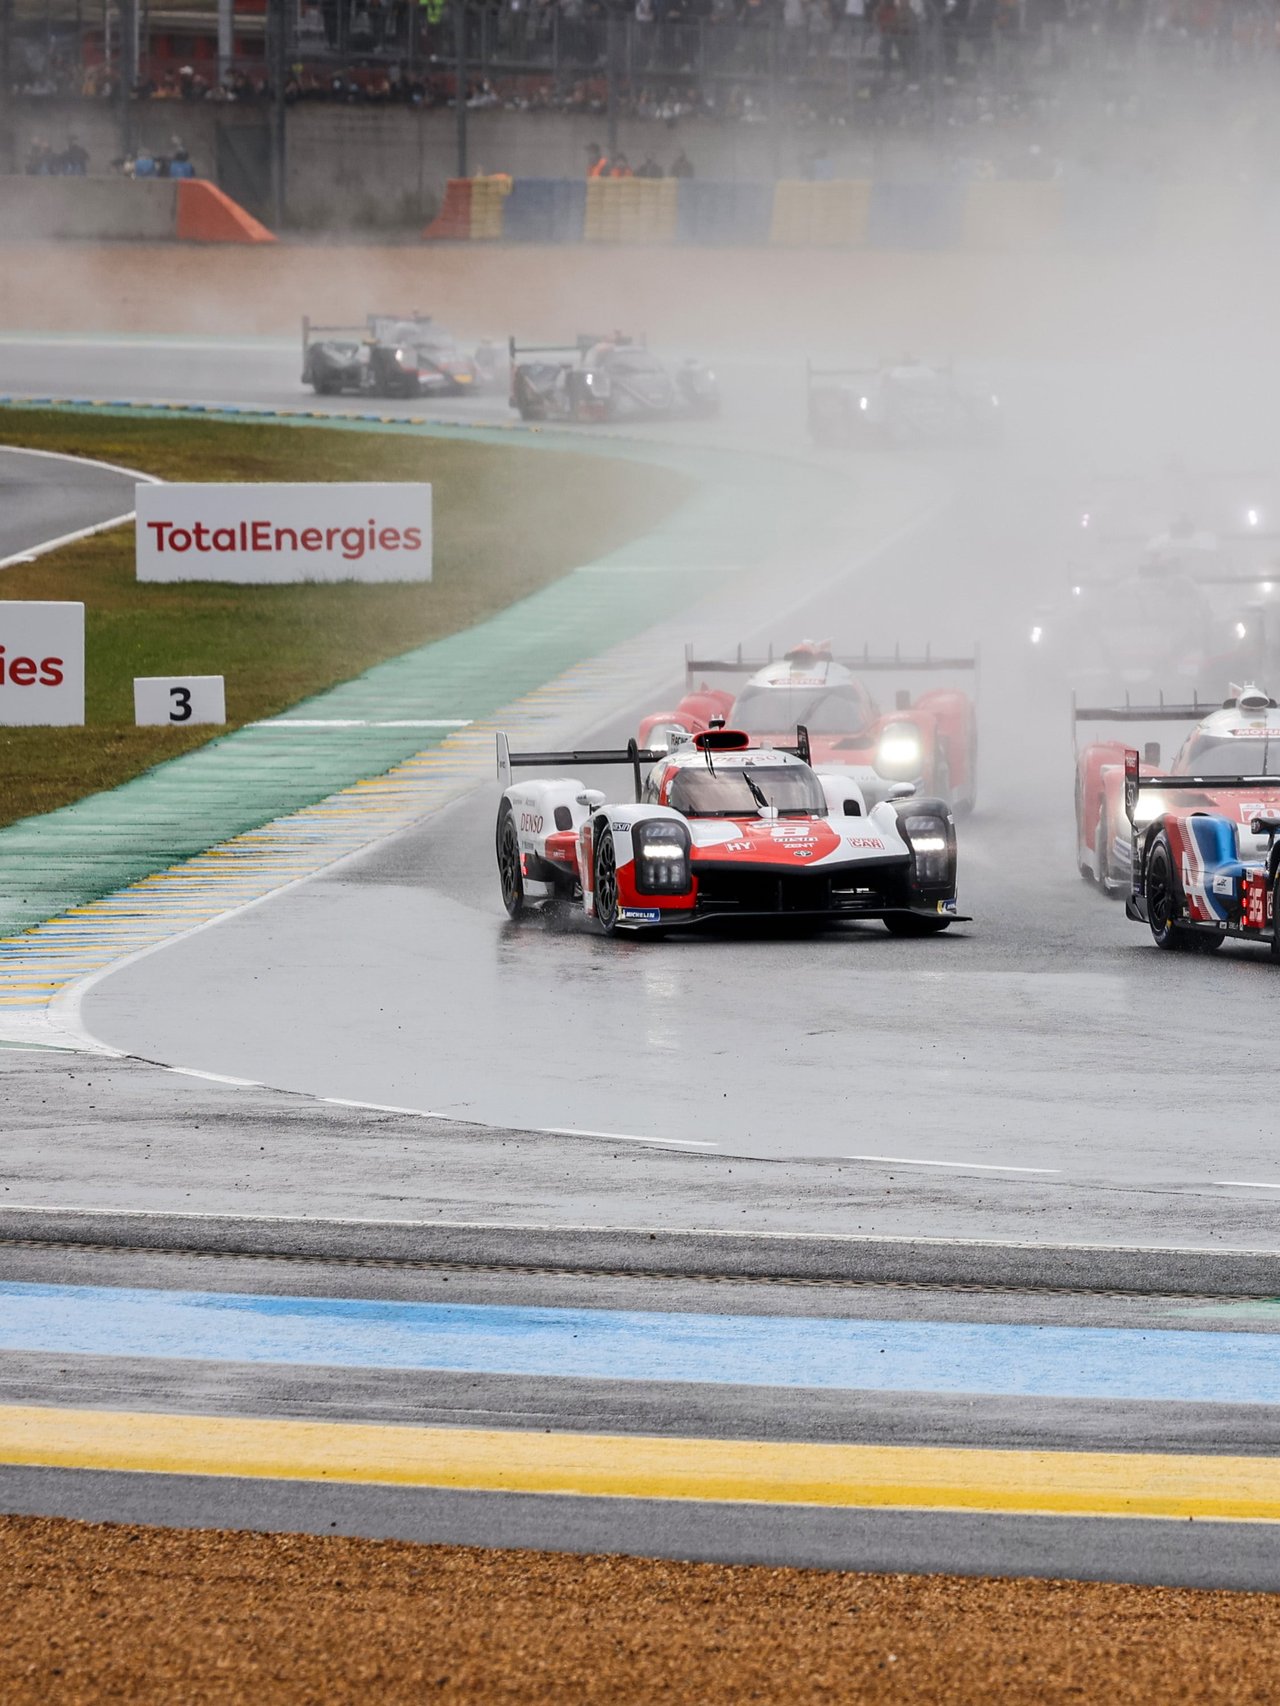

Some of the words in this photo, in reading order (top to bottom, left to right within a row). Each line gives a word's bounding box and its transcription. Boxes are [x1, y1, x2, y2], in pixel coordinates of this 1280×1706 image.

[147, 519, 422, 560] TotalEnergies
[0, 644, 64, 686] ies
[169, 687, 192, 721] 3
[521, 812, 544, 834] DENSO
[770, 826, 810, 837] 8
[726, 841, 751, 851] HY
[852, 841, 881, 849] CAR
[1249, 887, 1263, 922] 36
